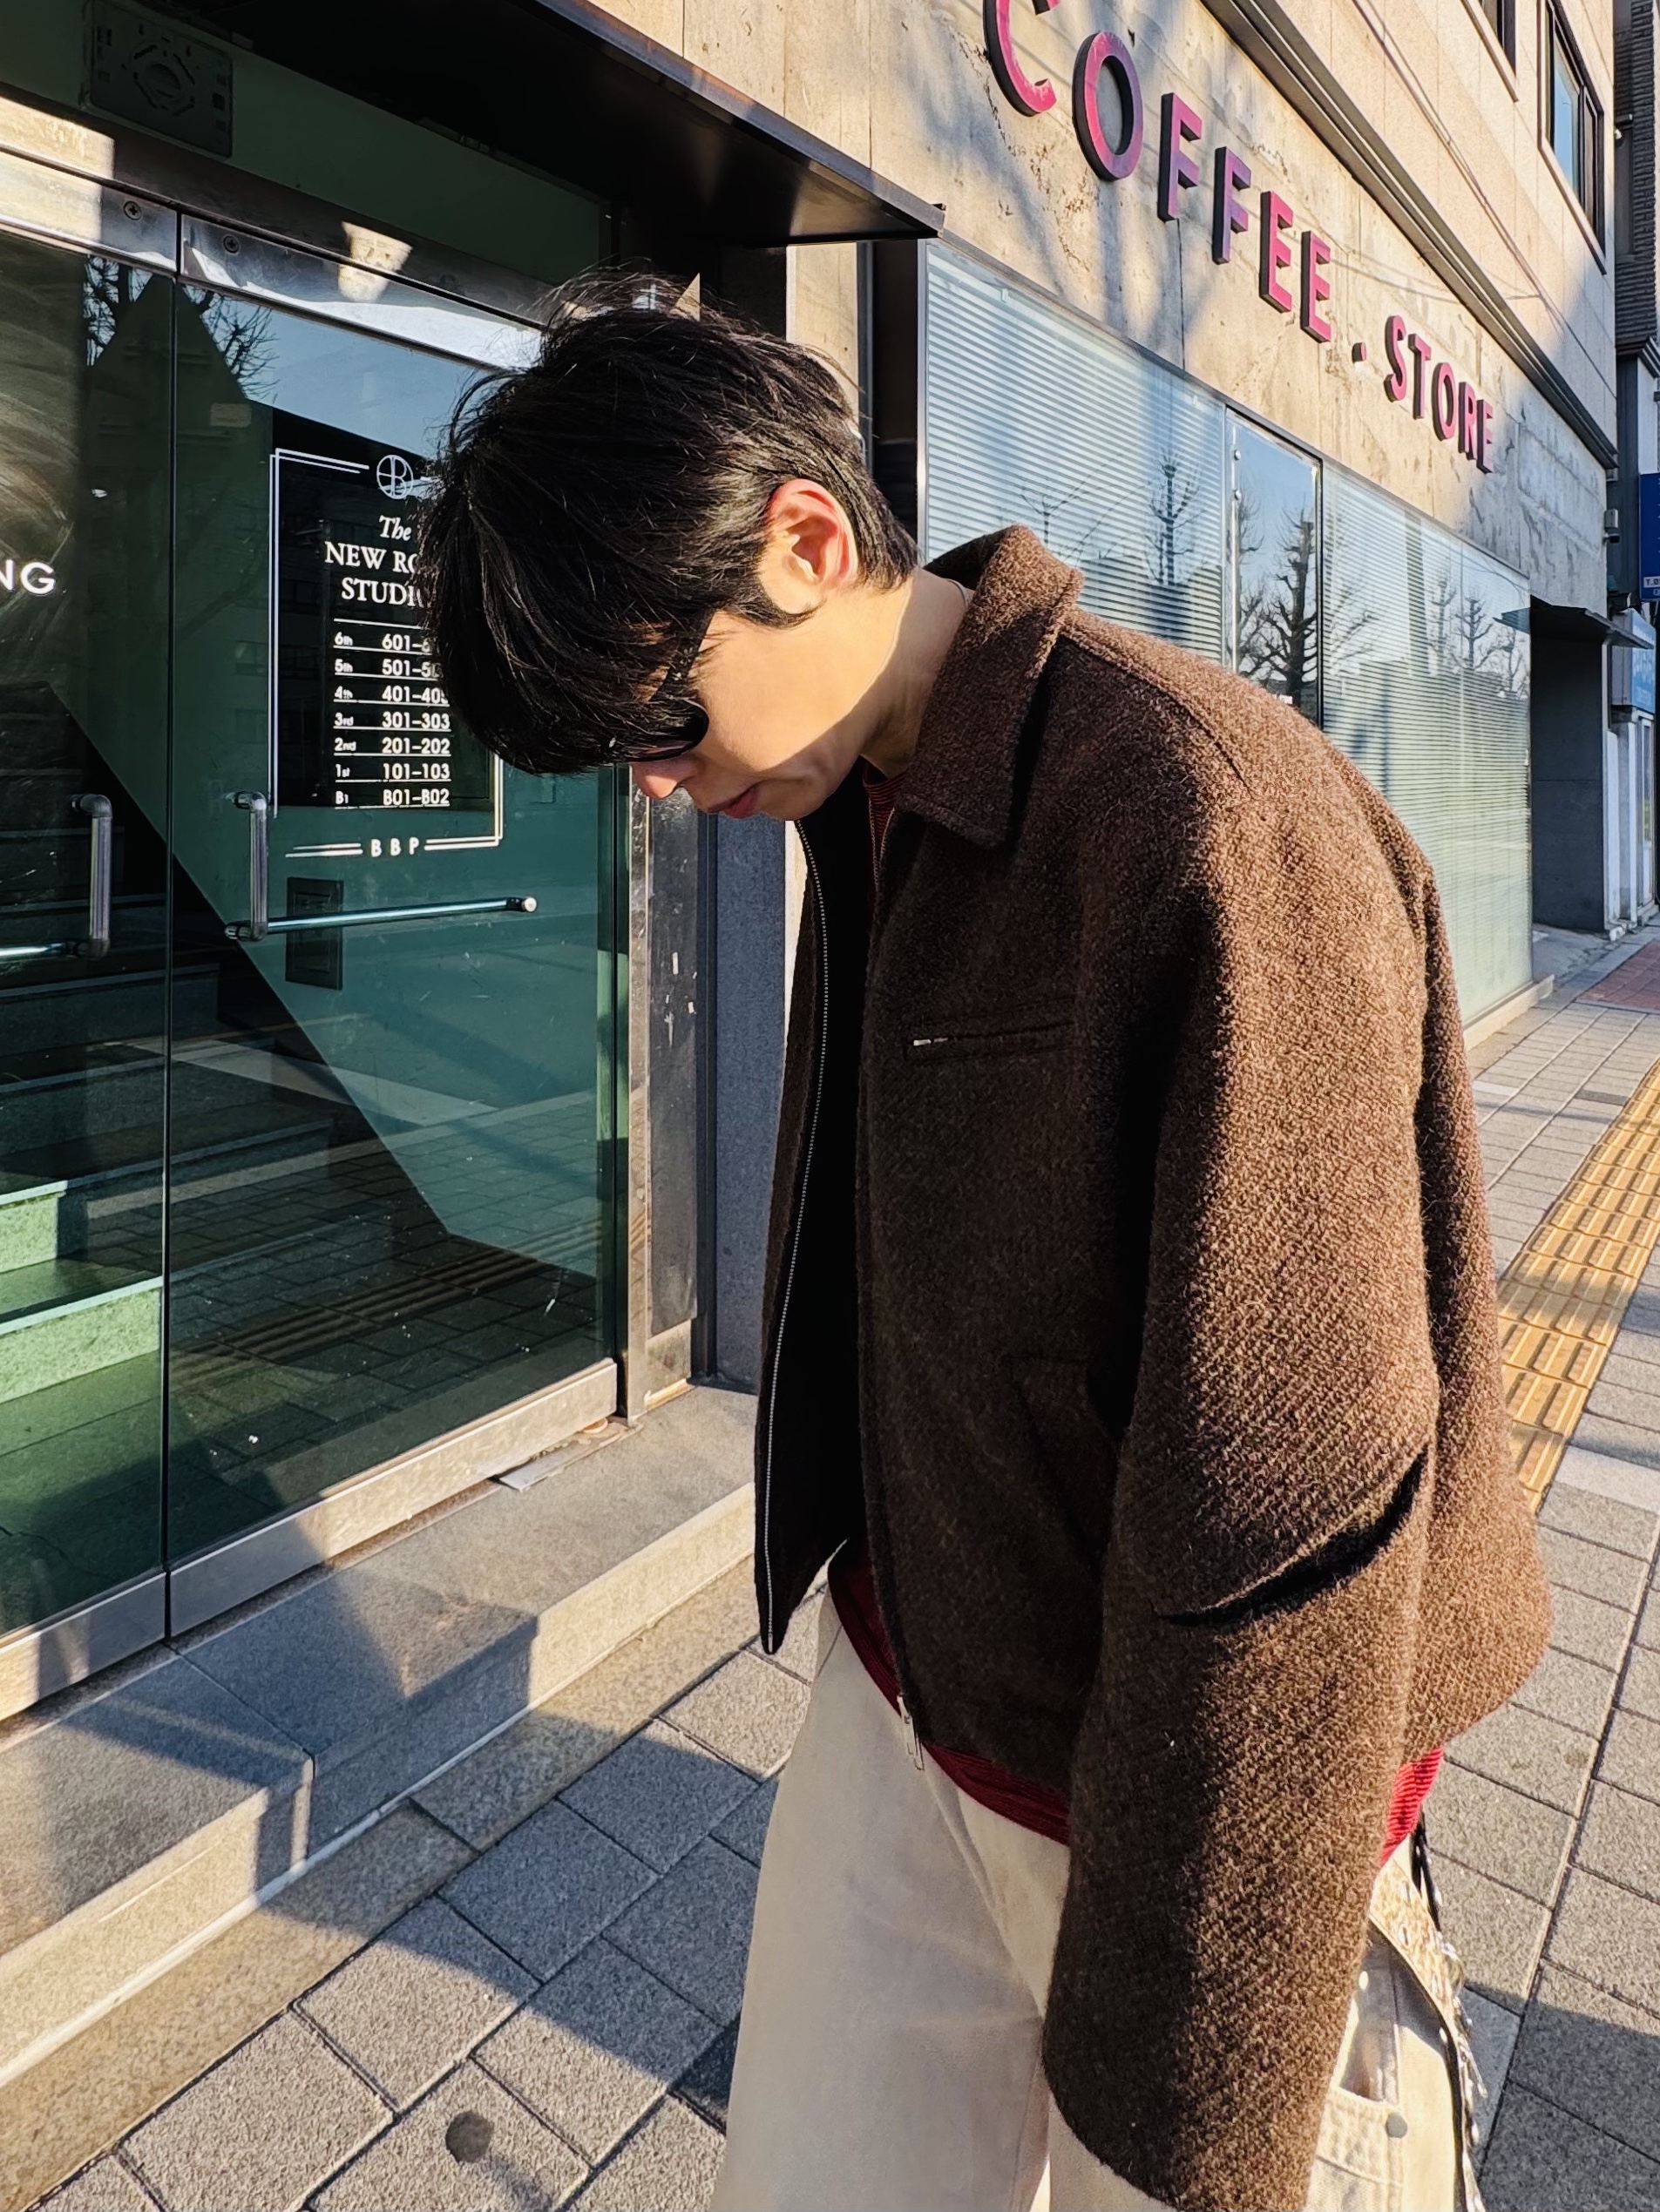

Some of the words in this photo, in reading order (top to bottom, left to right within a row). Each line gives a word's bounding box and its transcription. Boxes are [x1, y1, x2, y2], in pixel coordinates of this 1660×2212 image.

[983, 0, 1331, 343] COFFEE
[1384, 315, 1494, 474] STORE
[379, 515, 411, 541] The
[324, 541, 387, 570] NEW
[335, 712, 354, 727] 3rd
[382, 711, 451, 729] 301-303
[335, 737, 356, 752] 2nd
[382, 737, 451, 754] 201-202
[335, 764, 350, 777] 1st
[383, 763, 451, 780] 101-103
[335, 790, 349, 804] B1
[383, 788, 450, 806] B01-B02
